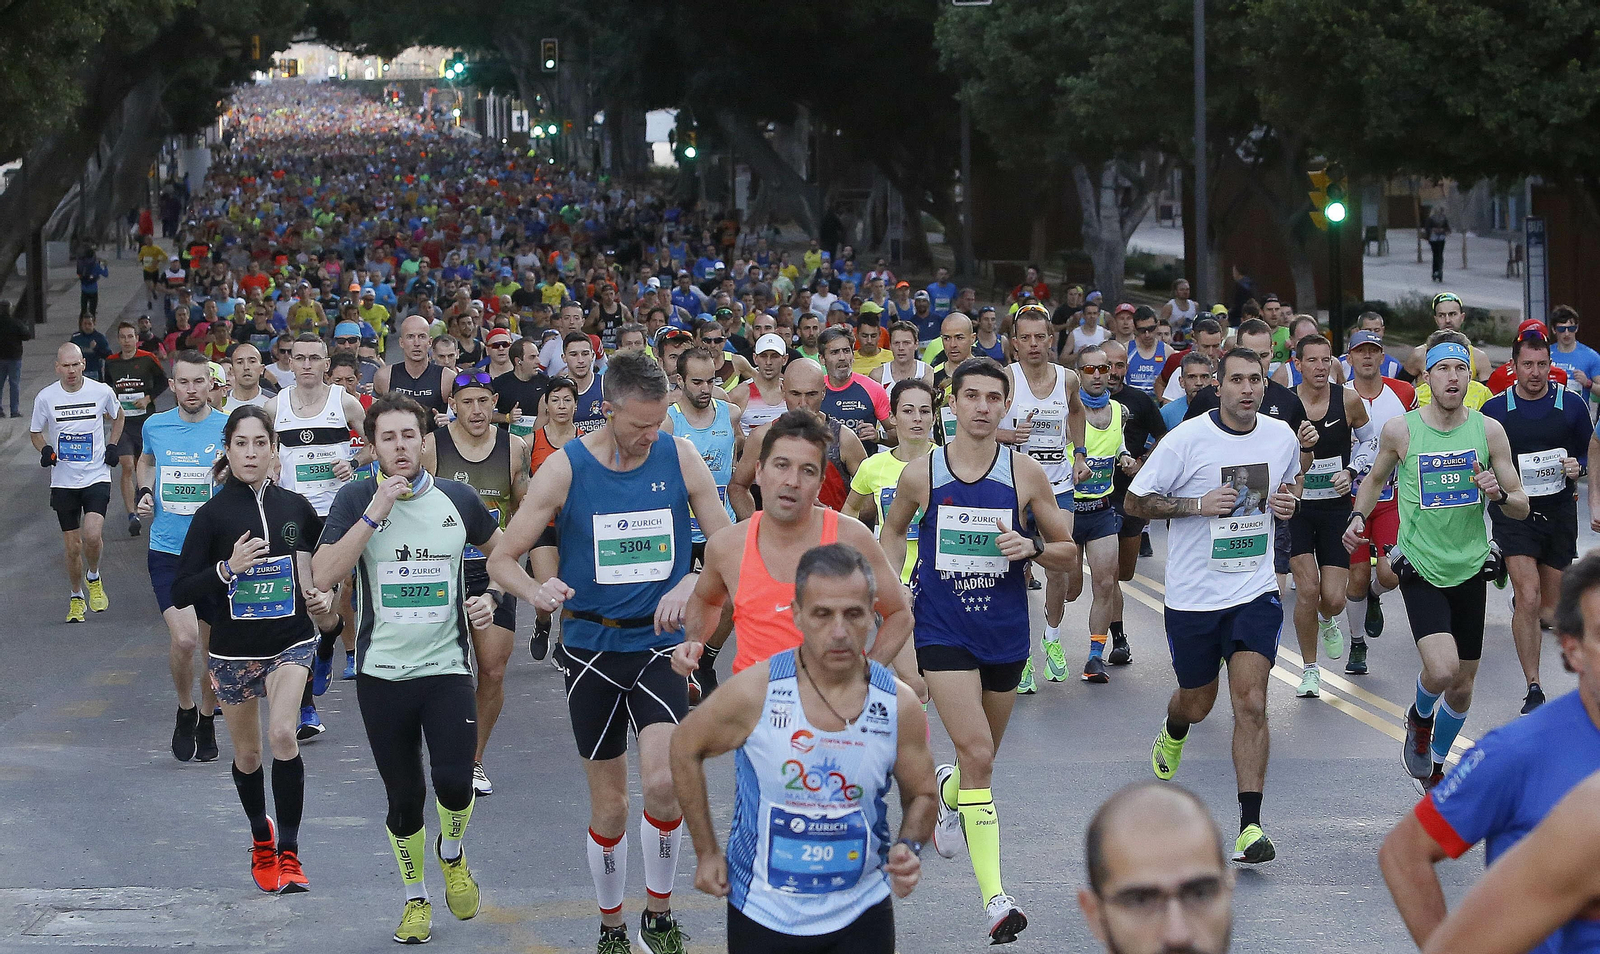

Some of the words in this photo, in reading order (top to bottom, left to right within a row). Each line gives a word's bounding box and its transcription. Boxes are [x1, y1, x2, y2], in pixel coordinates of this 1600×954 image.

[310, 465, 330, 474] 5385
[1536, 468, 1555, 478] 7582
[1440, 474, 1460, 484] 839
[174, 486, 196, 494] 5202
[632, 519, 662, 527] ZURICH
[959, 534, 988, 545] 5147
[1230, 538, 1254, 549] 5355
[620, 540, 651, 553] 5304
[416, 548, 429, 558] 54
[254, 582, 274, 594] 727
[954, 578, 995, 590] MADRID
[401, 586, 430, 597] 5272
[781, 759, 864, 802] 2020
[808, 822, 848, 832] ZURICH
[802, 845, 834, 862] 290
